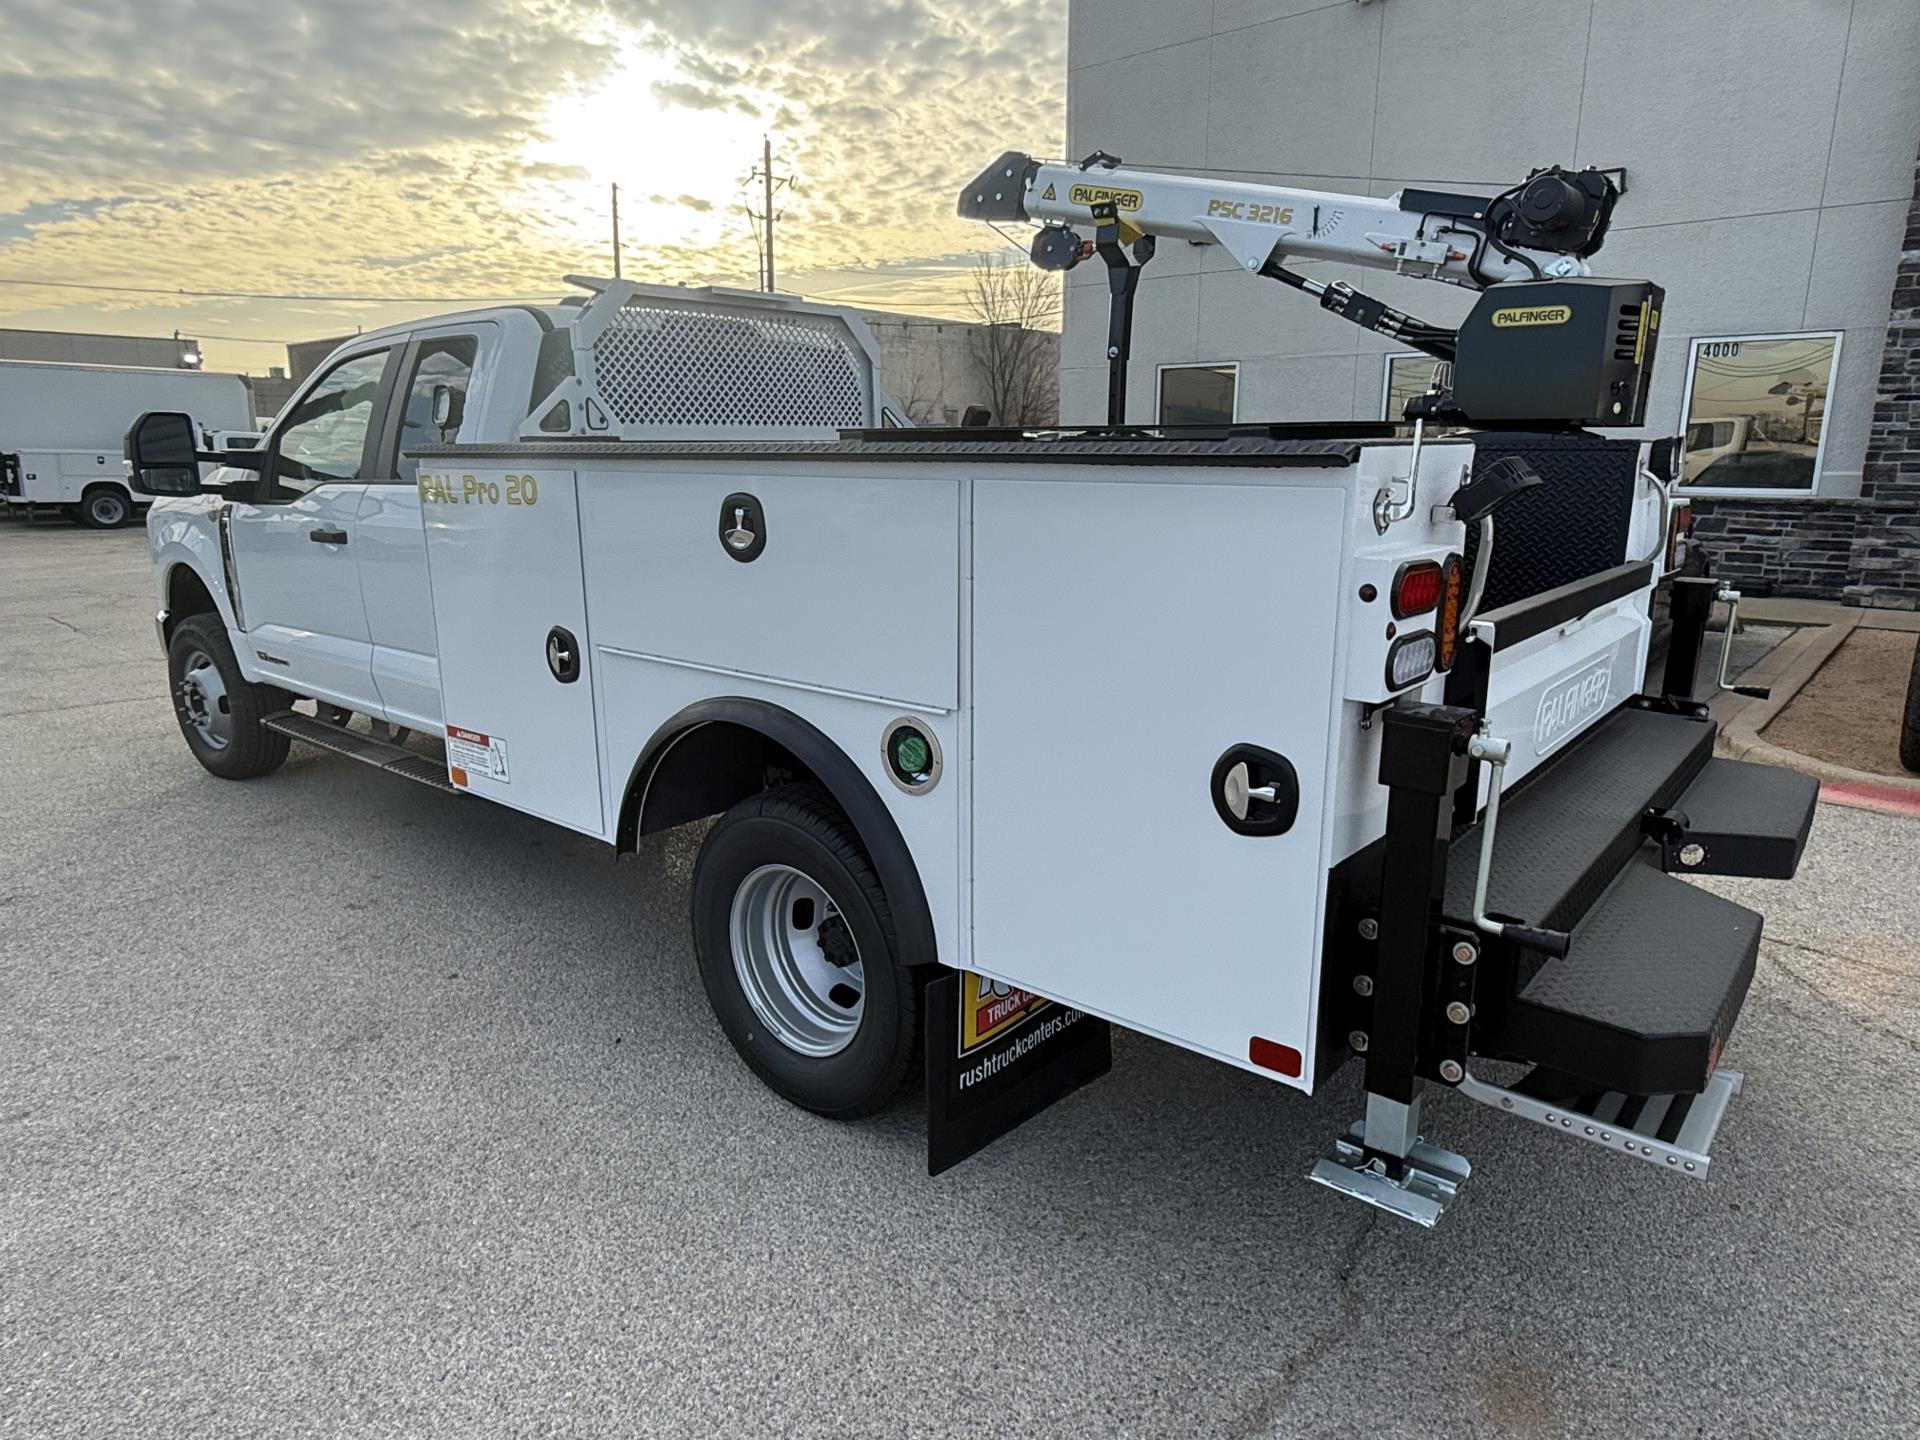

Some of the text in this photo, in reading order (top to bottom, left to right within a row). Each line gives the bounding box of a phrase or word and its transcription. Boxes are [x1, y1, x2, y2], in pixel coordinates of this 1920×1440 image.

[1073, 188, 1139, 208] PALFINGER
[1207, 199, 1245, 220] PSC
[1247, 203, 1294, 225] 3216
[1497, 309, 1566, 324] PALFINGER
[1703, 342, 1739, 358] 4000
[420, 474, 538, 505] PAL Pro 20
[987, 991, 1021, 1024] TRUCK
